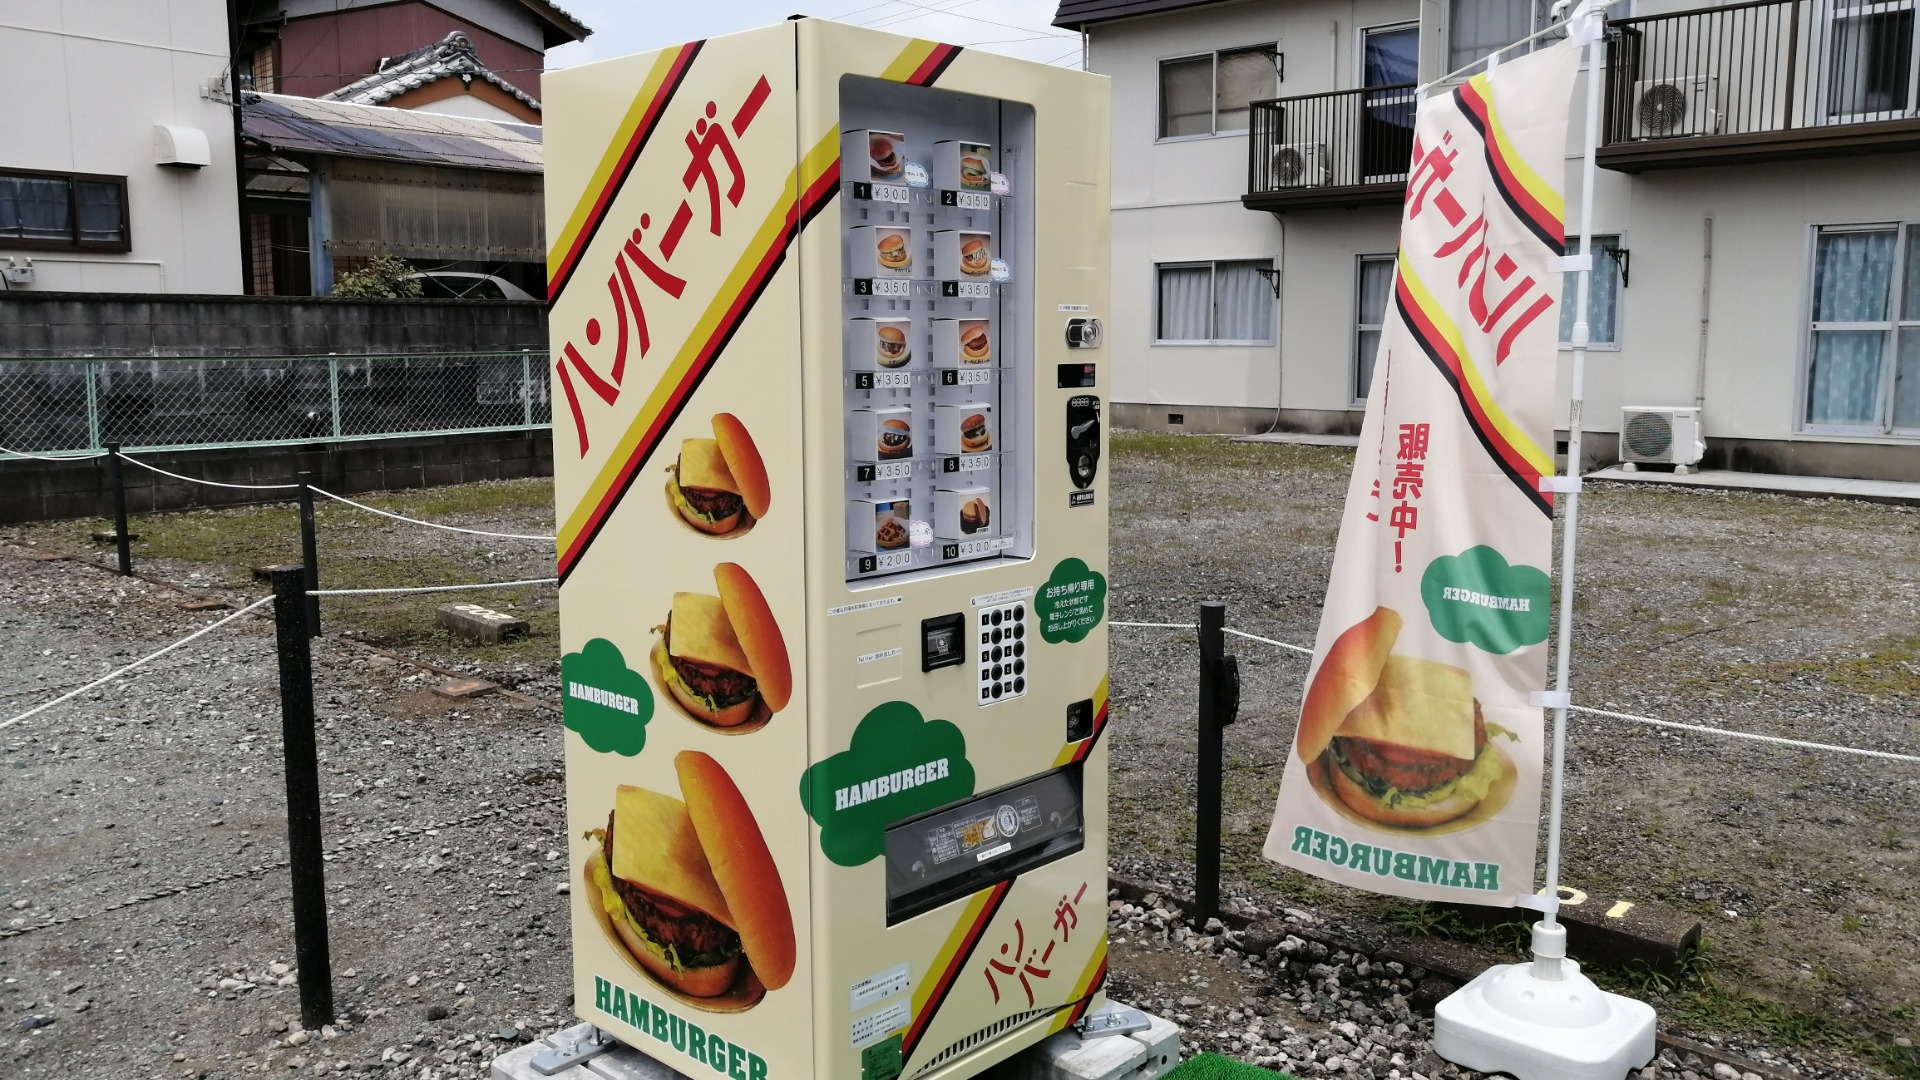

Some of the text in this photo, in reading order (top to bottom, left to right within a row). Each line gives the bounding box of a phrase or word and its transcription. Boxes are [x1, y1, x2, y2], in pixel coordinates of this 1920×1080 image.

[874, 186, 907, 202] ¥300
[958, 194, 988, 207] ¥350
[555, 74, 772, 460] ハンバーガー
[874, 281, 908, 293] ¥350
[959, 284, 989, 296] ¥350
[875, 374, 909, 386] ¥350
[959, 371, 989, 382] ¥350
[877, 464, 910, 477] ¥350
[960, 456, 989, 469] ¥350
[946, 546, 956, 558] 10
[960, 541, 989, 555] ¥300
[877, 552, 910, 567] ¥200
[1046, 579, 1094, 598] お持ち帰り専用
[569, 682, 639, 715] HAMBURGER
[835, 758, 949, 811] HAMBURGER
[1018, 881, 1087, 1010] バーガー
[984, 918, 1025, 1006] ハン
[594, 975, 769, 1080] HAMBURGER
